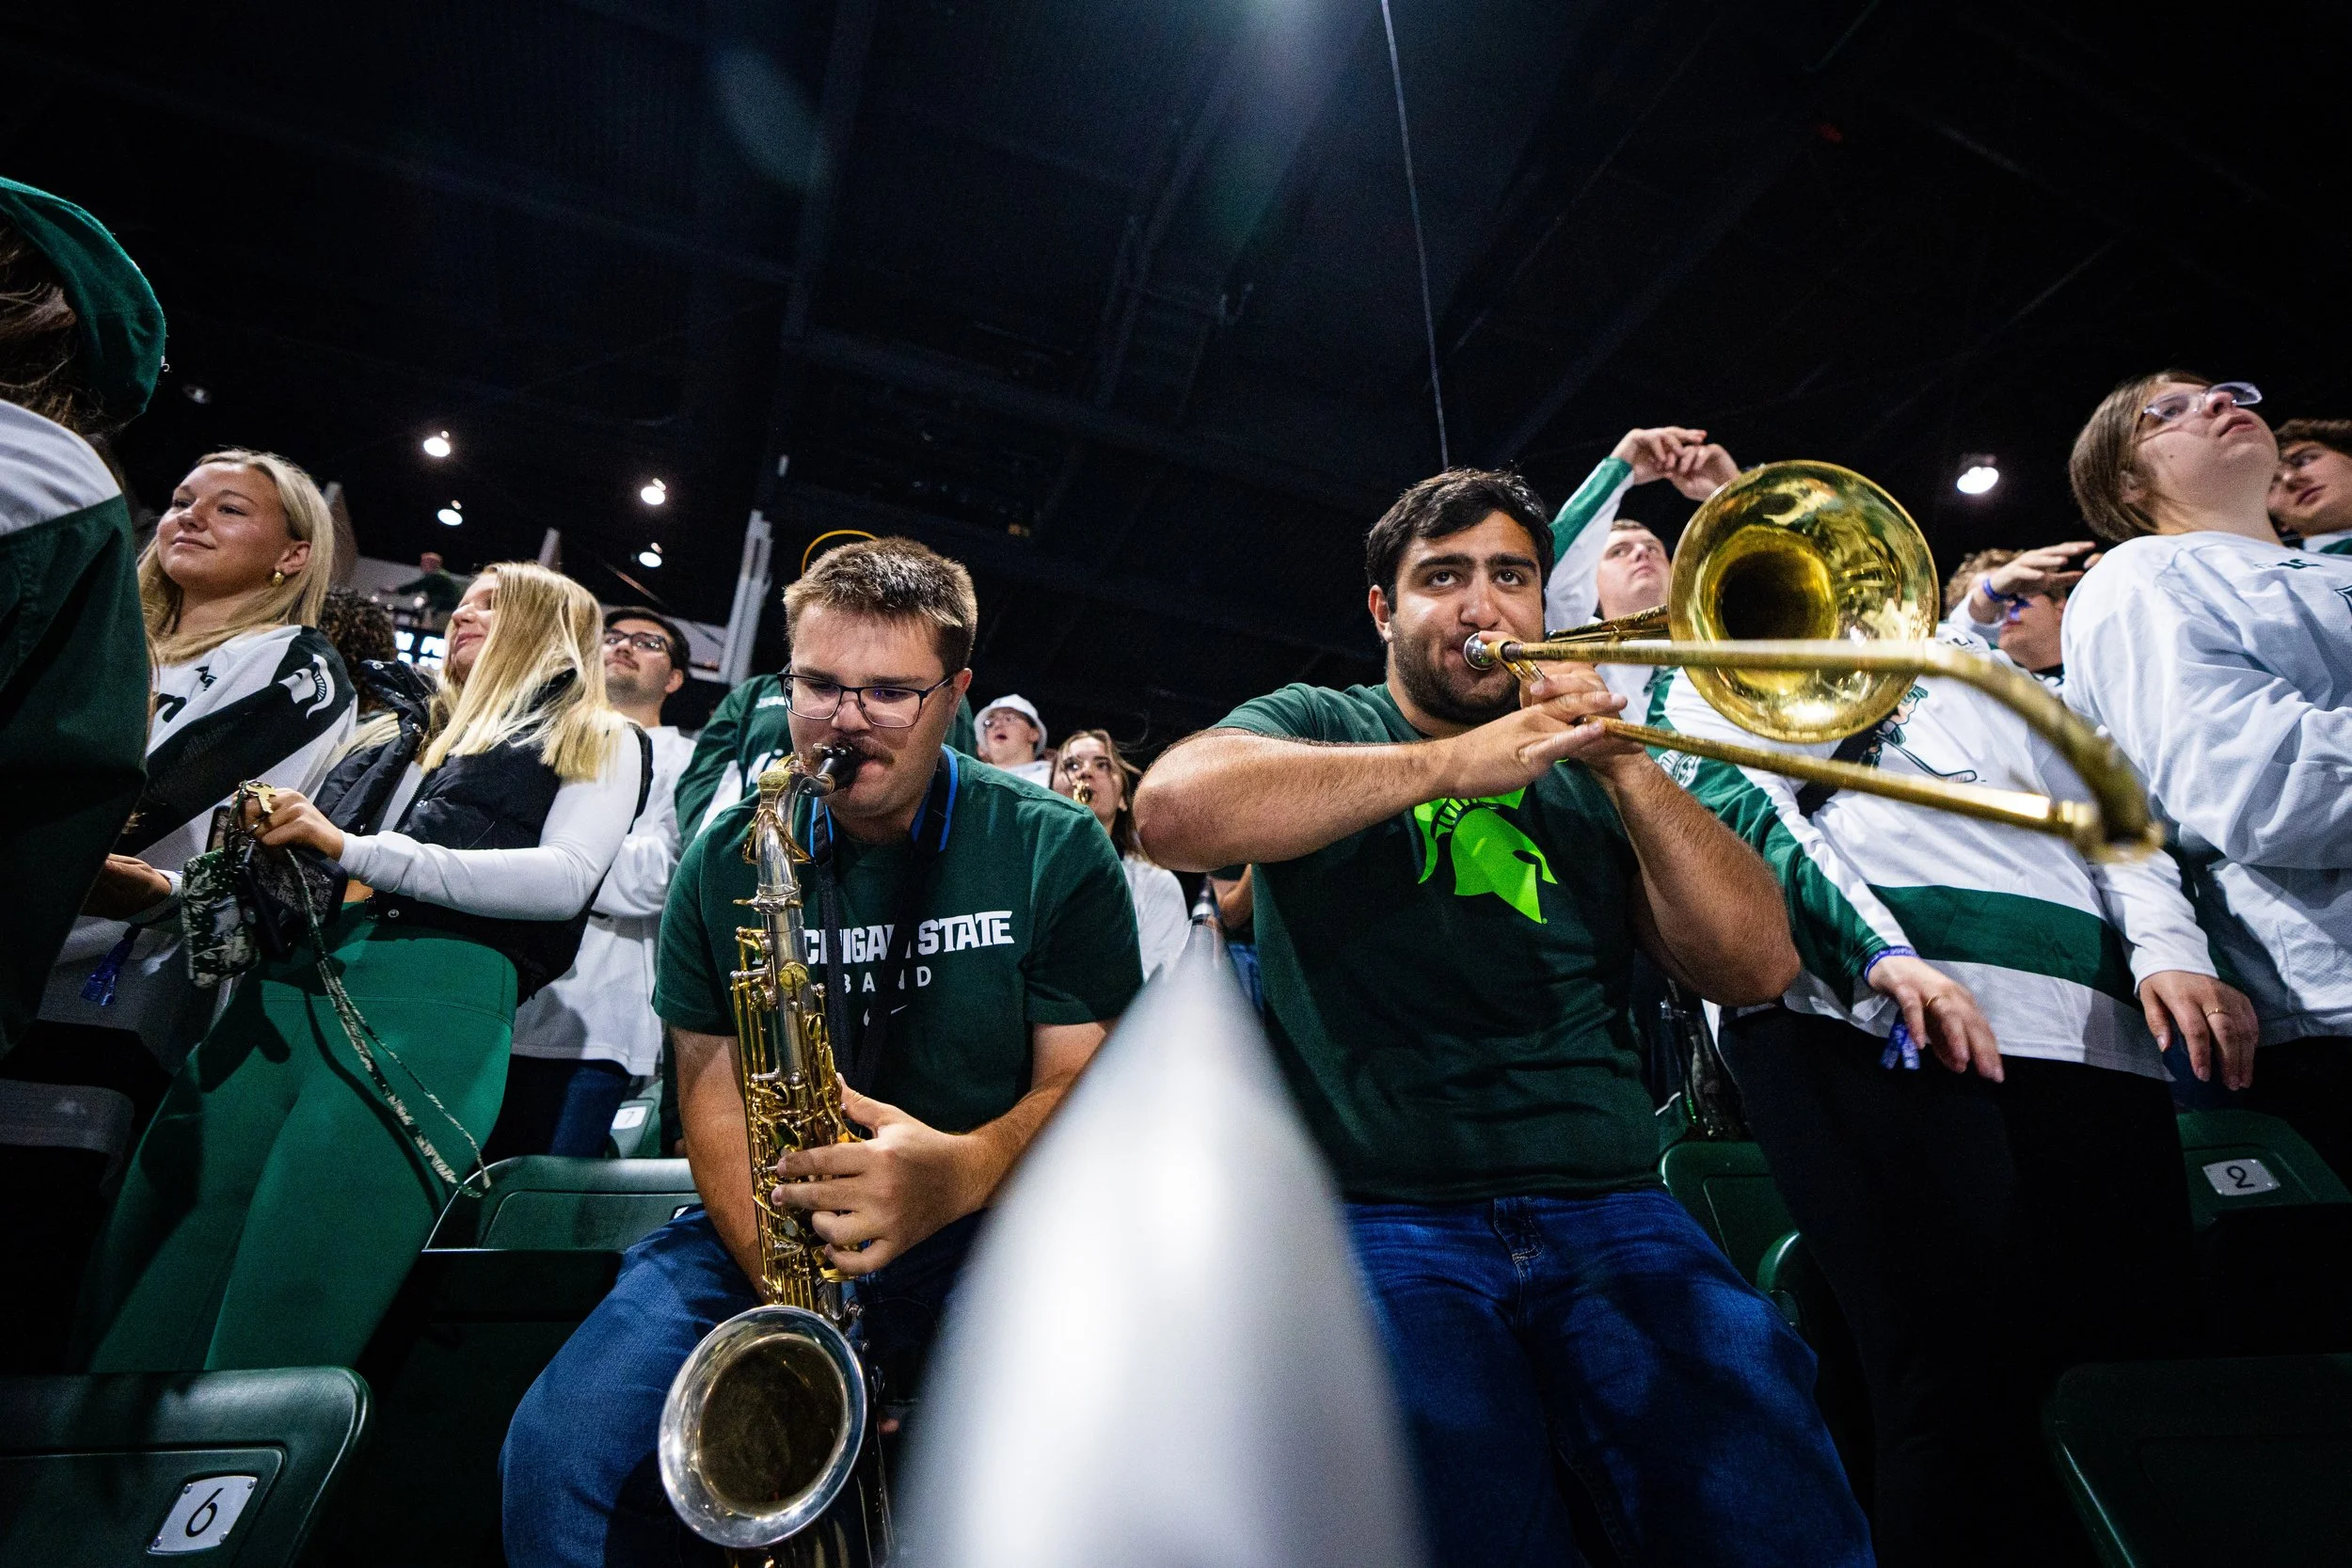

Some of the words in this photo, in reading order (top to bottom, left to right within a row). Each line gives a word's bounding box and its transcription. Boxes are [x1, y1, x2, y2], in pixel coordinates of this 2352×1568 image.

[917, 911, 1015, 956] STATE
[2226, 1165, 2255, 1189] 2
[185, 1487, 225, 1538] 6
